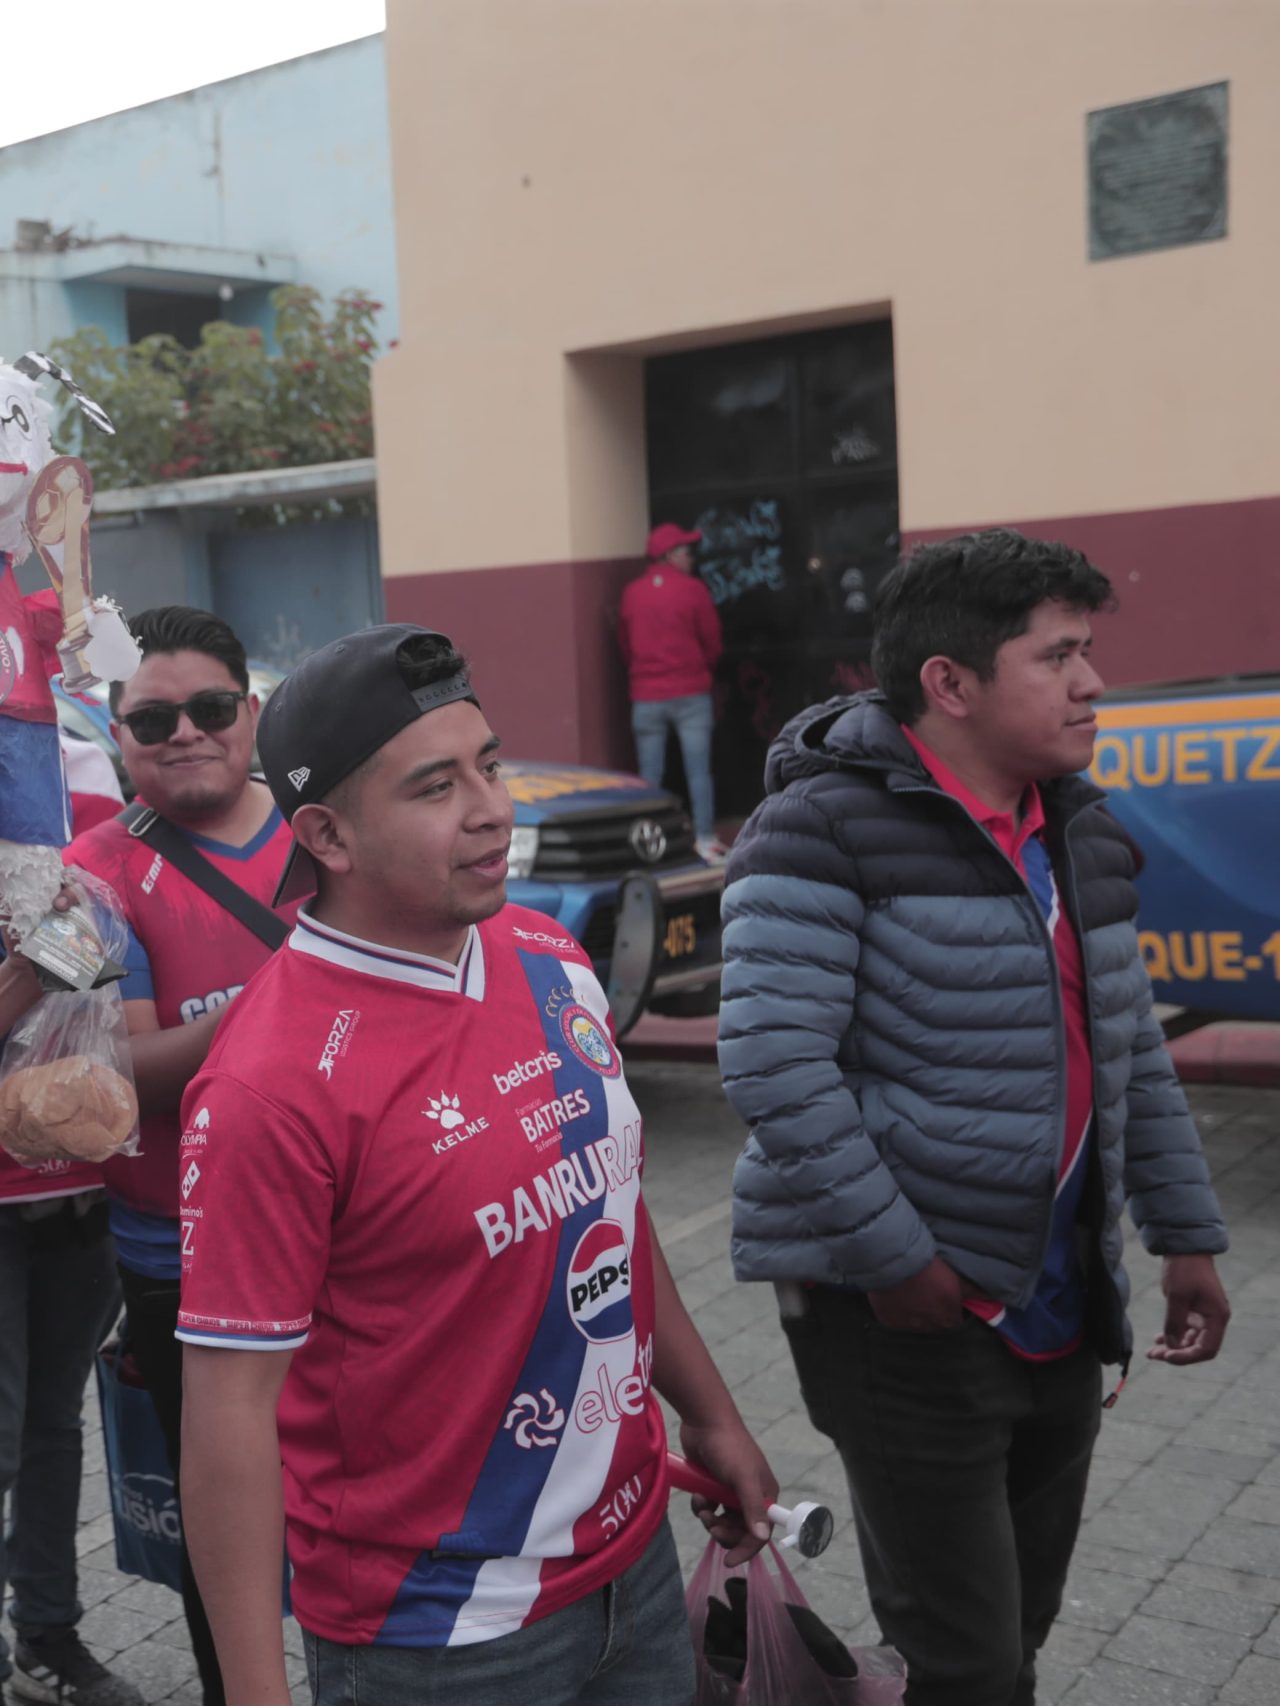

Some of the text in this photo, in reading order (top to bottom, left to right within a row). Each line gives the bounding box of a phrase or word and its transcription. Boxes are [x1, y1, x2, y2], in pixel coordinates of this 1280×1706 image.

[492, 1050, 563, 1095] betcris
[431, 1116, 491, 1155] KELME
[520, 1088, 591, 1144] BATRES
[570, 1252, 630, 1313] PEPS
